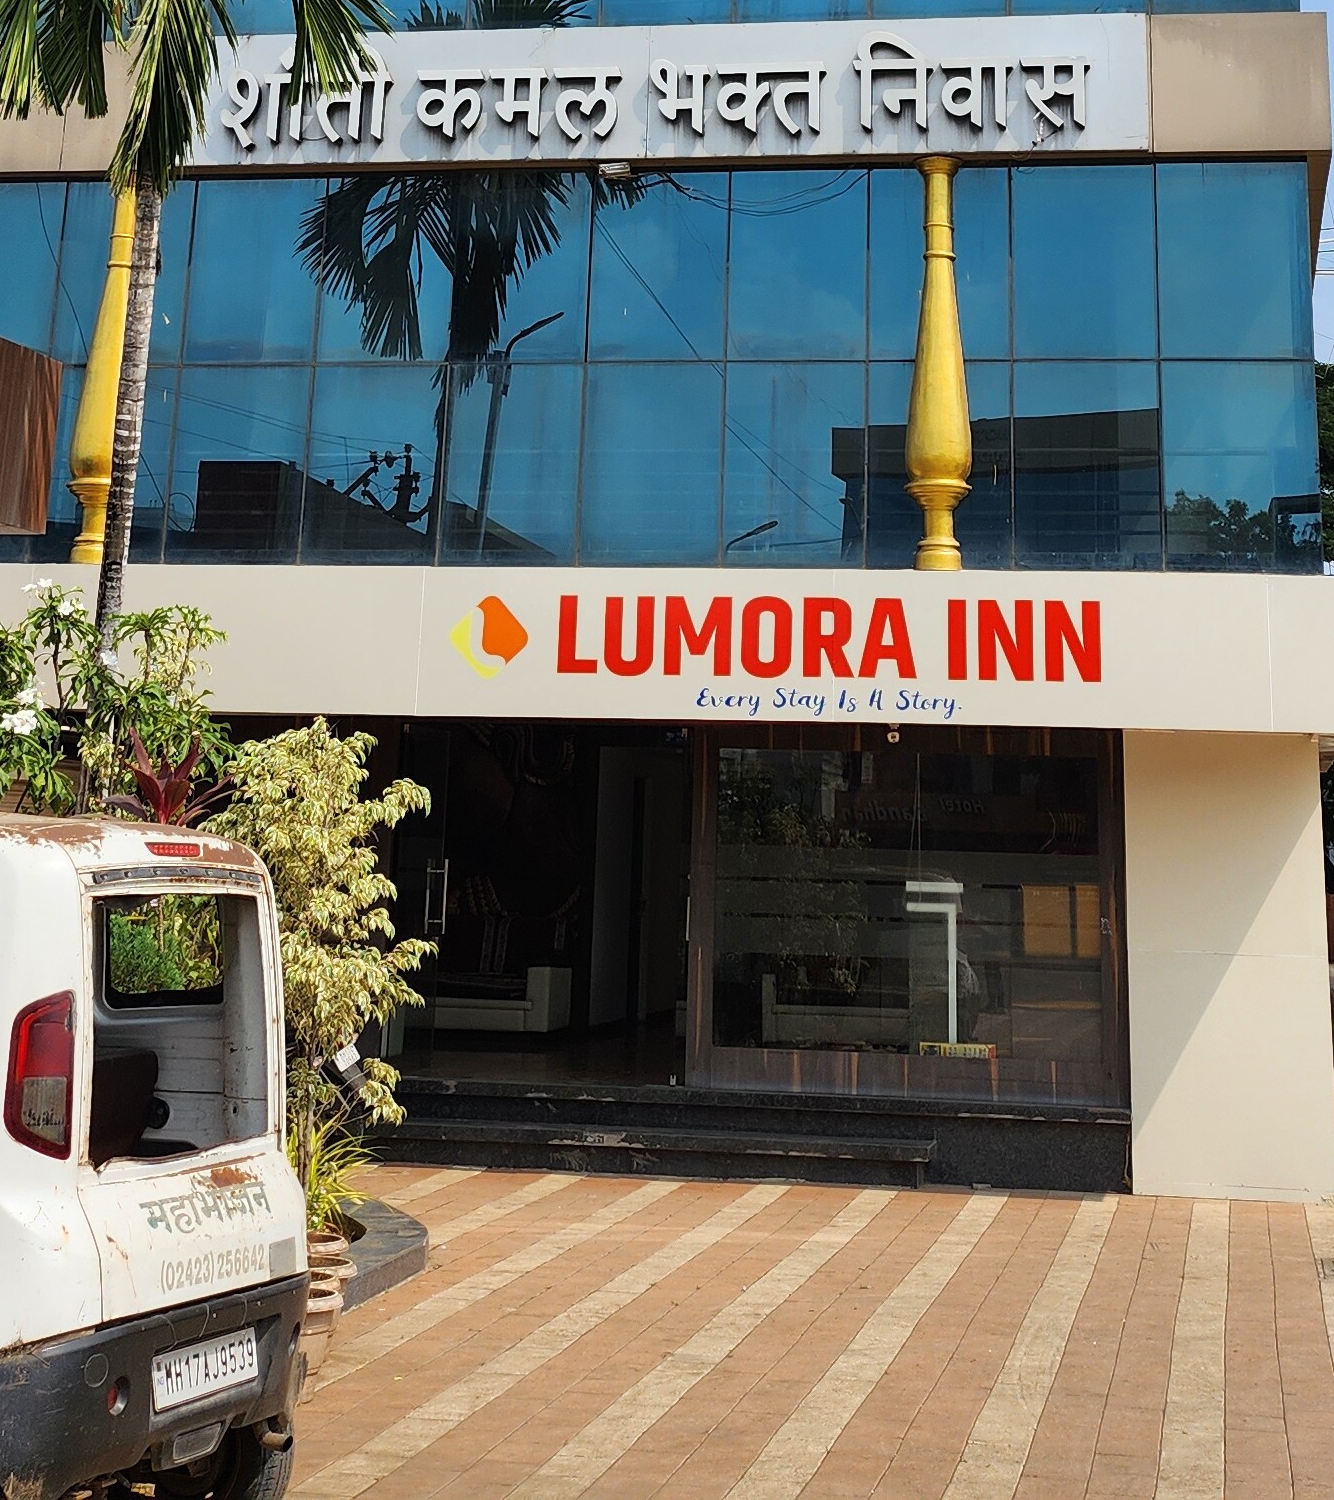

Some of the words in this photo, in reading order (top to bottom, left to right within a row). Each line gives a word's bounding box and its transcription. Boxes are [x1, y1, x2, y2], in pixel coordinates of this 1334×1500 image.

[416, 66, 623, 142] कमल
[650, 57, 826, 137] भक्त
[853, 30, 1091, 132] निवास
[556, 593, 917, 679] LUMORA
[947, 598, 1102, 683] INN
[696, 687, 761, 716] Every
[772, 687, 827, 716] Stay
[838, 689, 860, 713] Is
[868, 688, 884, 712] A
[896, 689, 963, 719] Story.
[164, 1337, 254, 1395] MH17AJ9539
